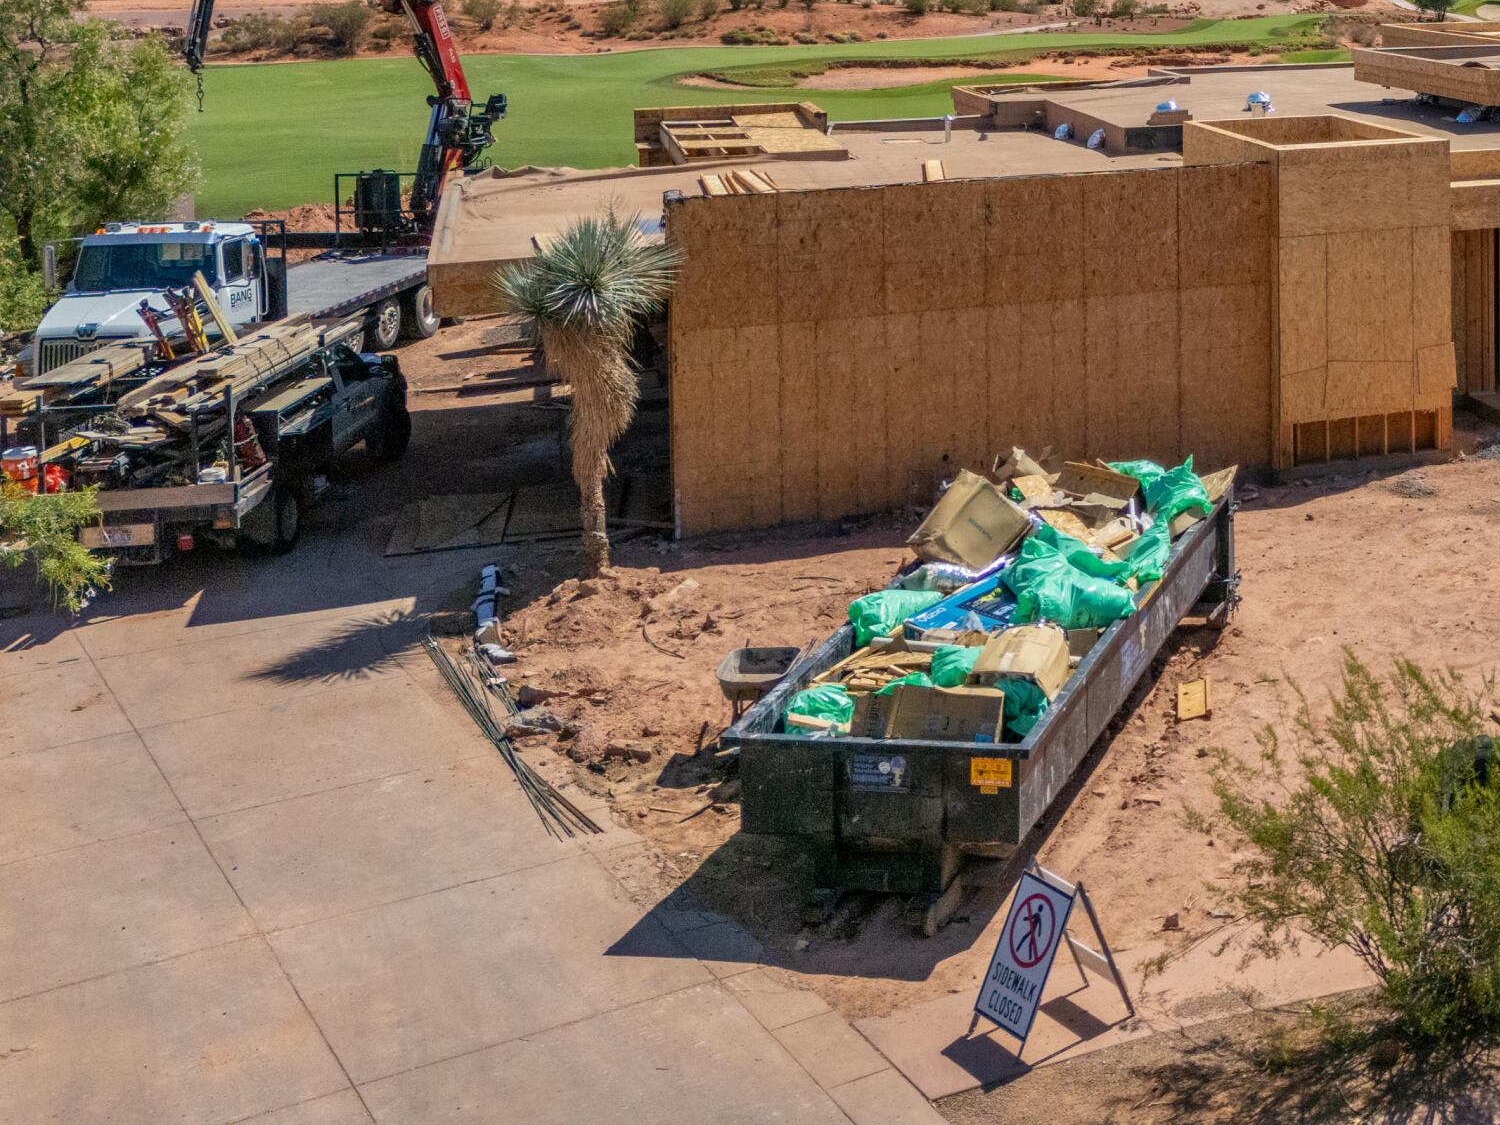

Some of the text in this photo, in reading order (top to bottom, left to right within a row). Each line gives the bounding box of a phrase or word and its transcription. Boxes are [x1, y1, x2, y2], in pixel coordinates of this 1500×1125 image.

[435, 7, 450, 38] FASSI
[230, 288, 252, 307] BANG
[992, 962, 1037, 1003] SIDEWALK
[988, 990, 1023, 1025] CLOSED
